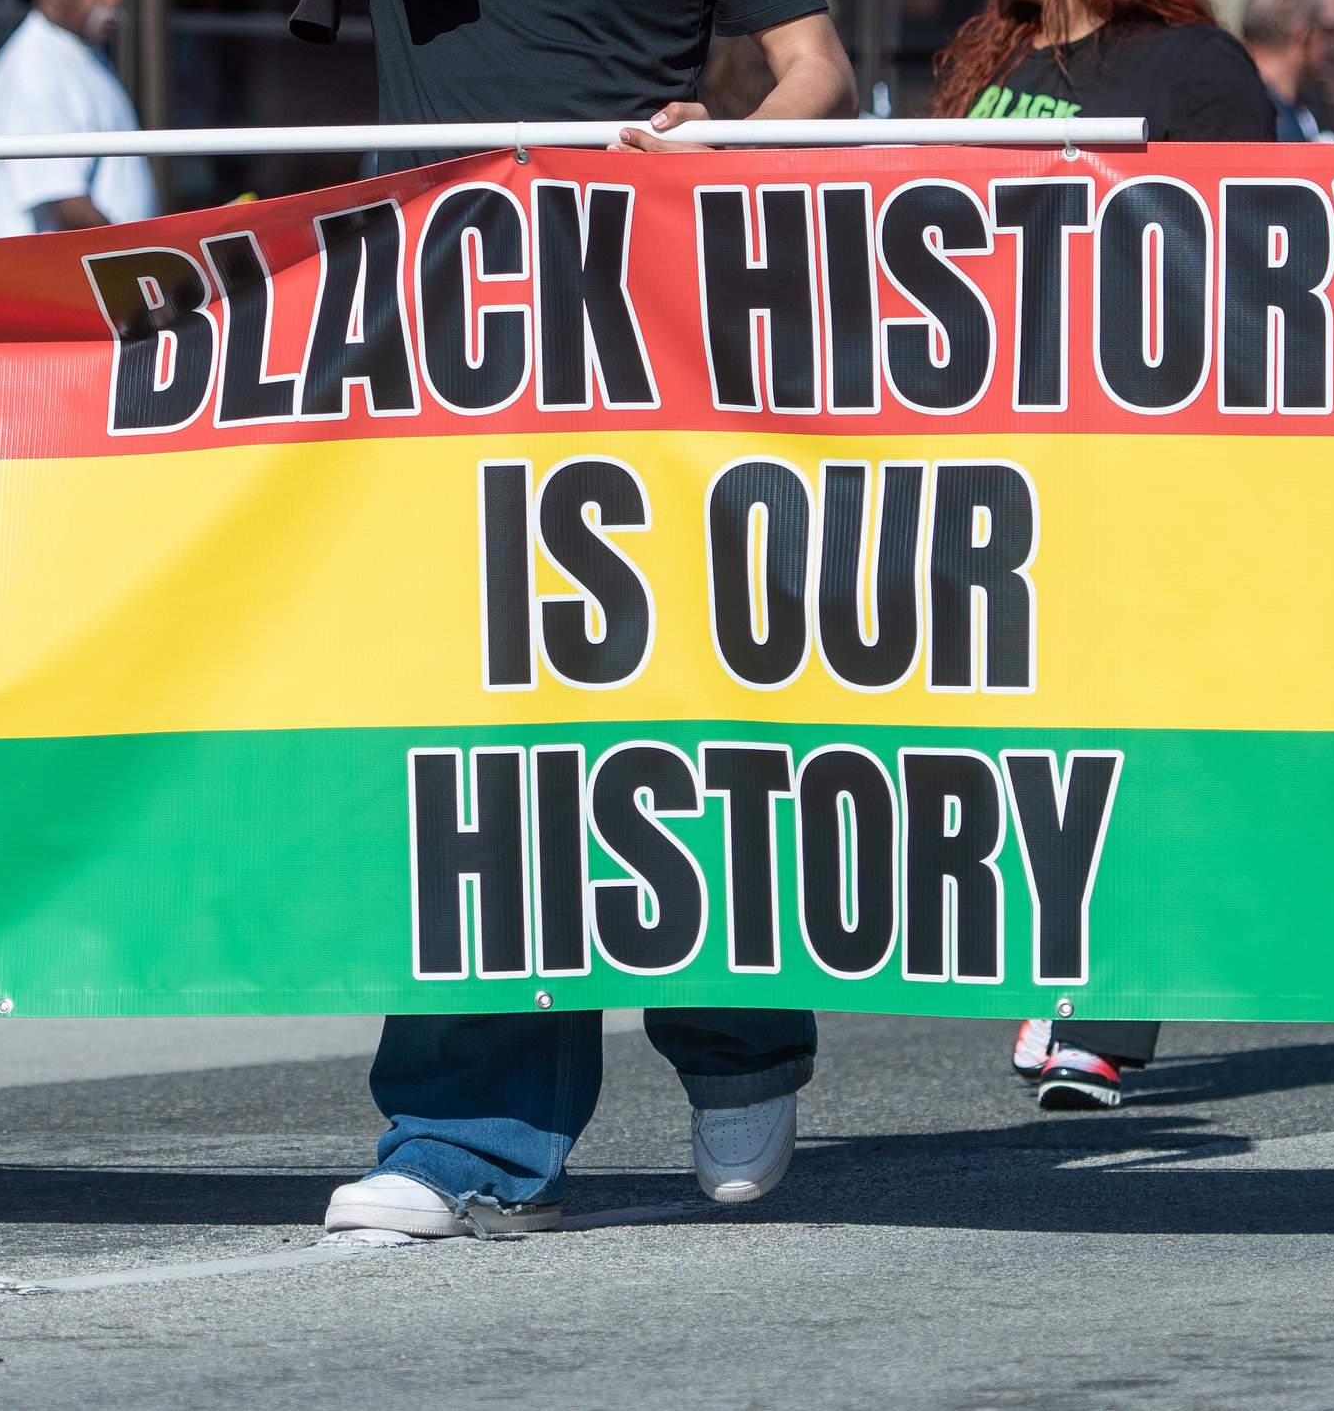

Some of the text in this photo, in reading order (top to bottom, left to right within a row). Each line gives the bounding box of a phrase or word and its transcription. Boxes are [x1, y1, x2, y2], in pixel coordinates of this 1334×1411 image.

[81, 180, 662, 435] BLACK
[478, 454, 1040, 694] IS OUR
[406, 741, 1124, 985] HISTORY
